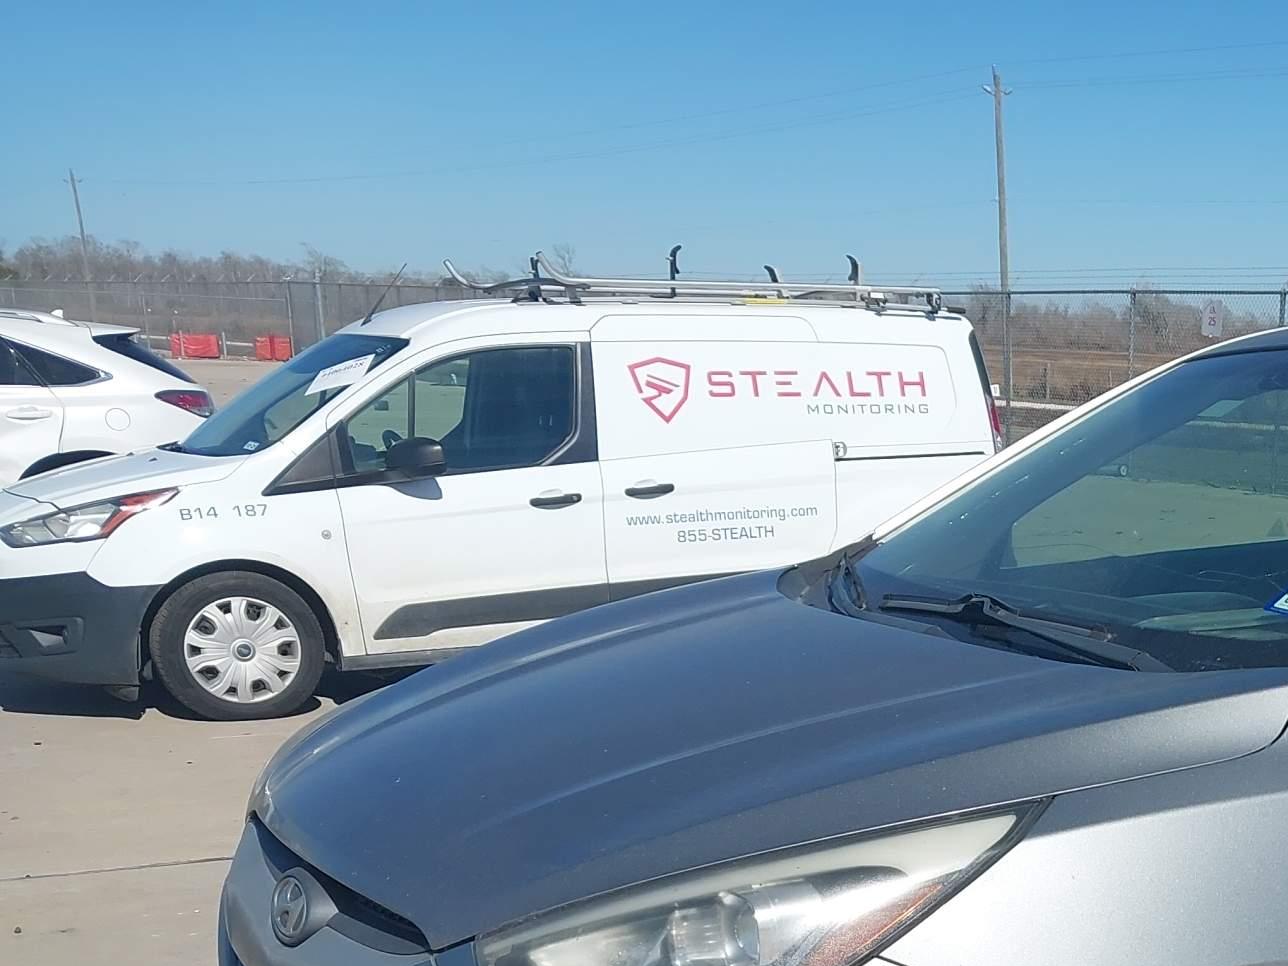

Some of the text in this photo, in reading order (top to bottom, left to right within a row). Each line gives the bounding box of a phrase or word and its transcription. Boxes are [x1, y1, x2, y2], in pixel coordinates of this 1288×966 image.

[706, 371, 927, 398] STEALTH
[807, 404, 929, 415] MONITORING
[179, 503, 268, 521] B14 187
[626, 506, 818, 526] www.stealthmonitoring.com
[677, 526, 775, 543] 855-STEALTH
